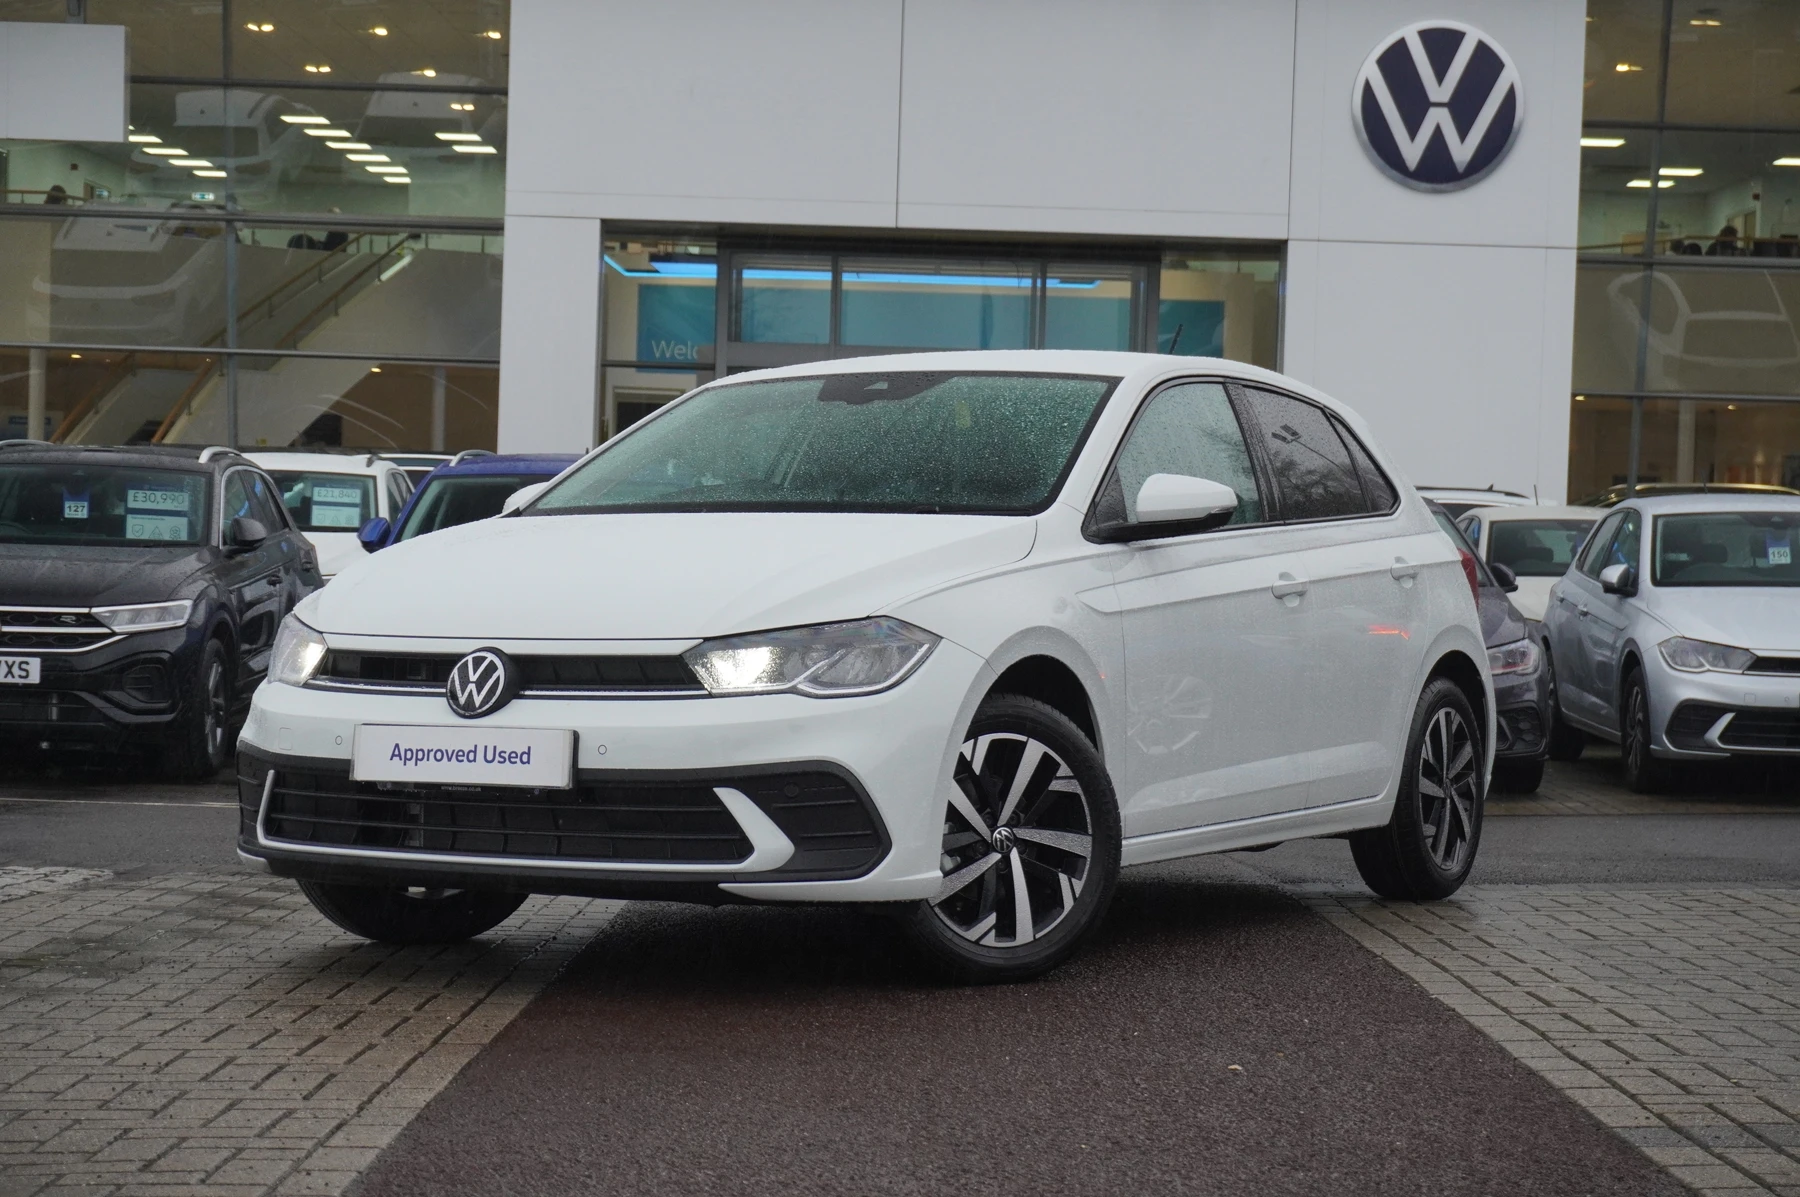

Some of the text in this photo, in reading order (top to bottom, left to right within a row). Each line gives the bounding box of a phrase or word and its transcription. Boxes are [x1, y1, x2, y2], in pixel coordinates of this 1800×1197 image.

[132, 491, 185, 506] £30,990
[66, 504, 86, 513] 127
[1771, 550, 1789, 559] 150
[0, 660, 30, 679] XS
[390, 743, 532, 766] Approved Used
